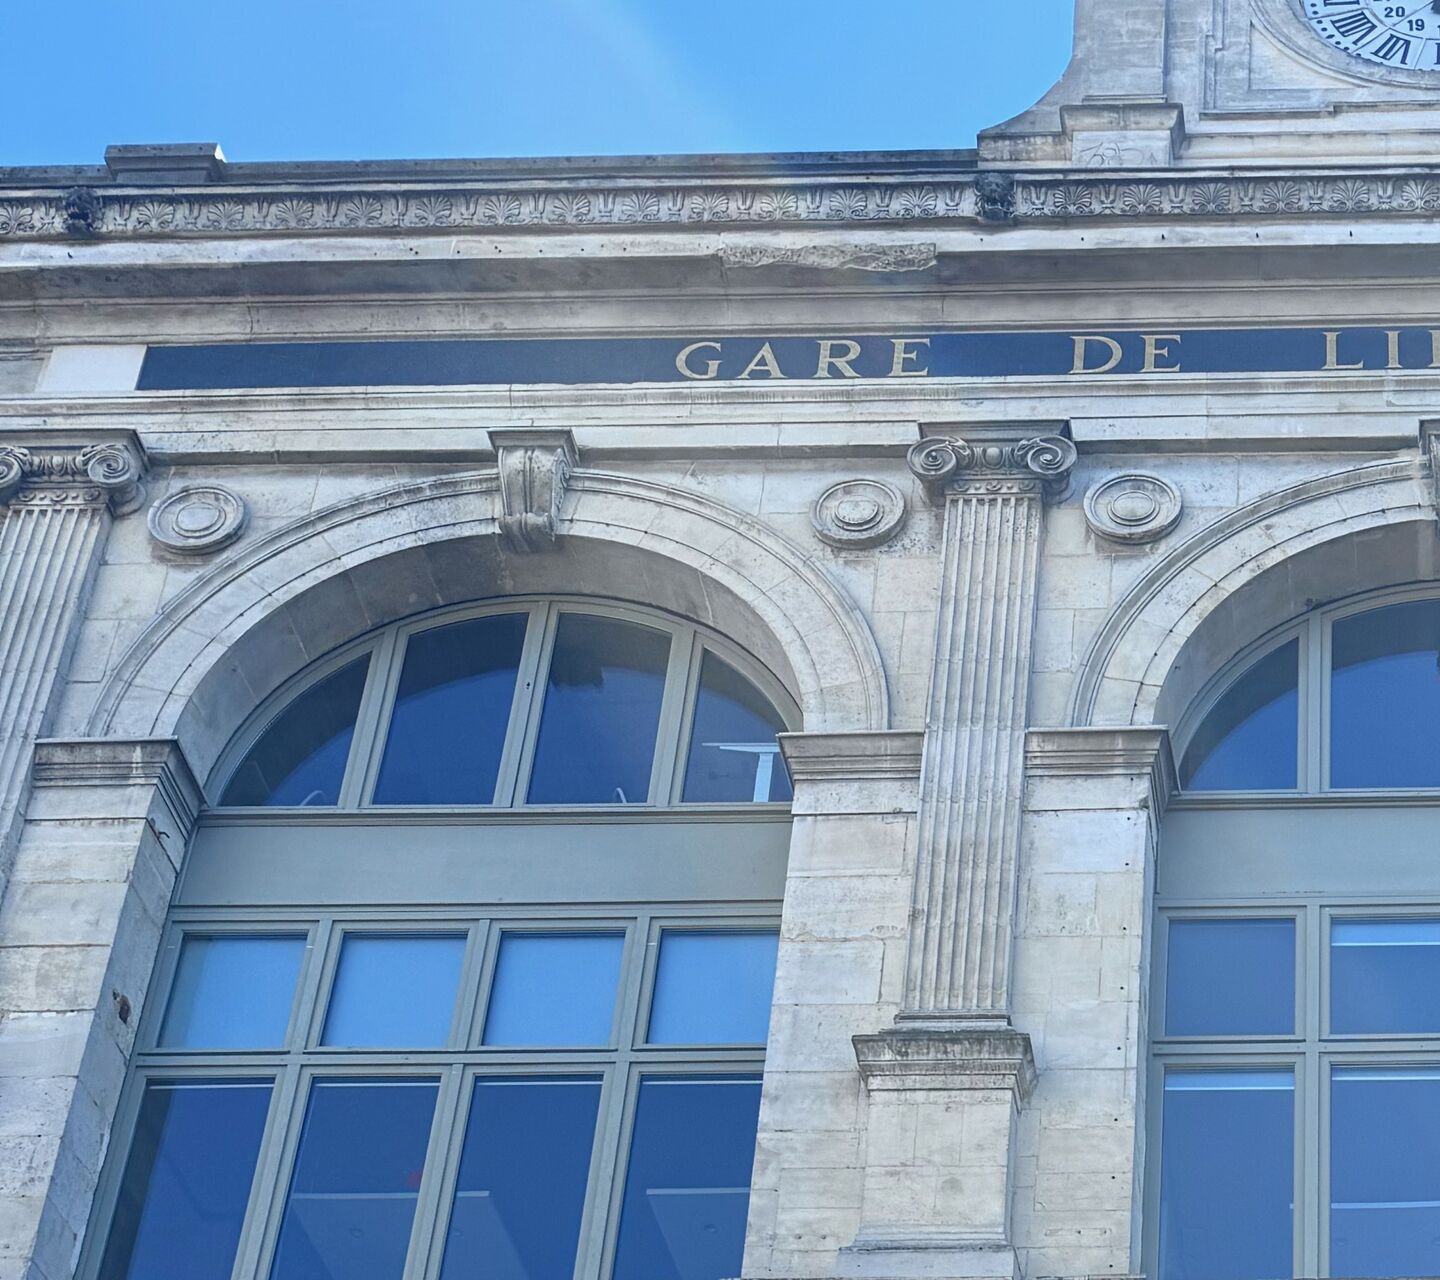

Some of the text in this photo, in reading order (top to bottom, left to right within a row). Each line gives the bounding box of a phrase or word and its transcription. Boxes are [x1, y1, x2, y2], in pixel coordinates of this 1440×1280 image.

[1384, 6, 1406, 18] 20
[1407, 18, 1425, 32] 19
[675, 337, 931, 380] GARE
[1068, 334, 1183, 376] DE
